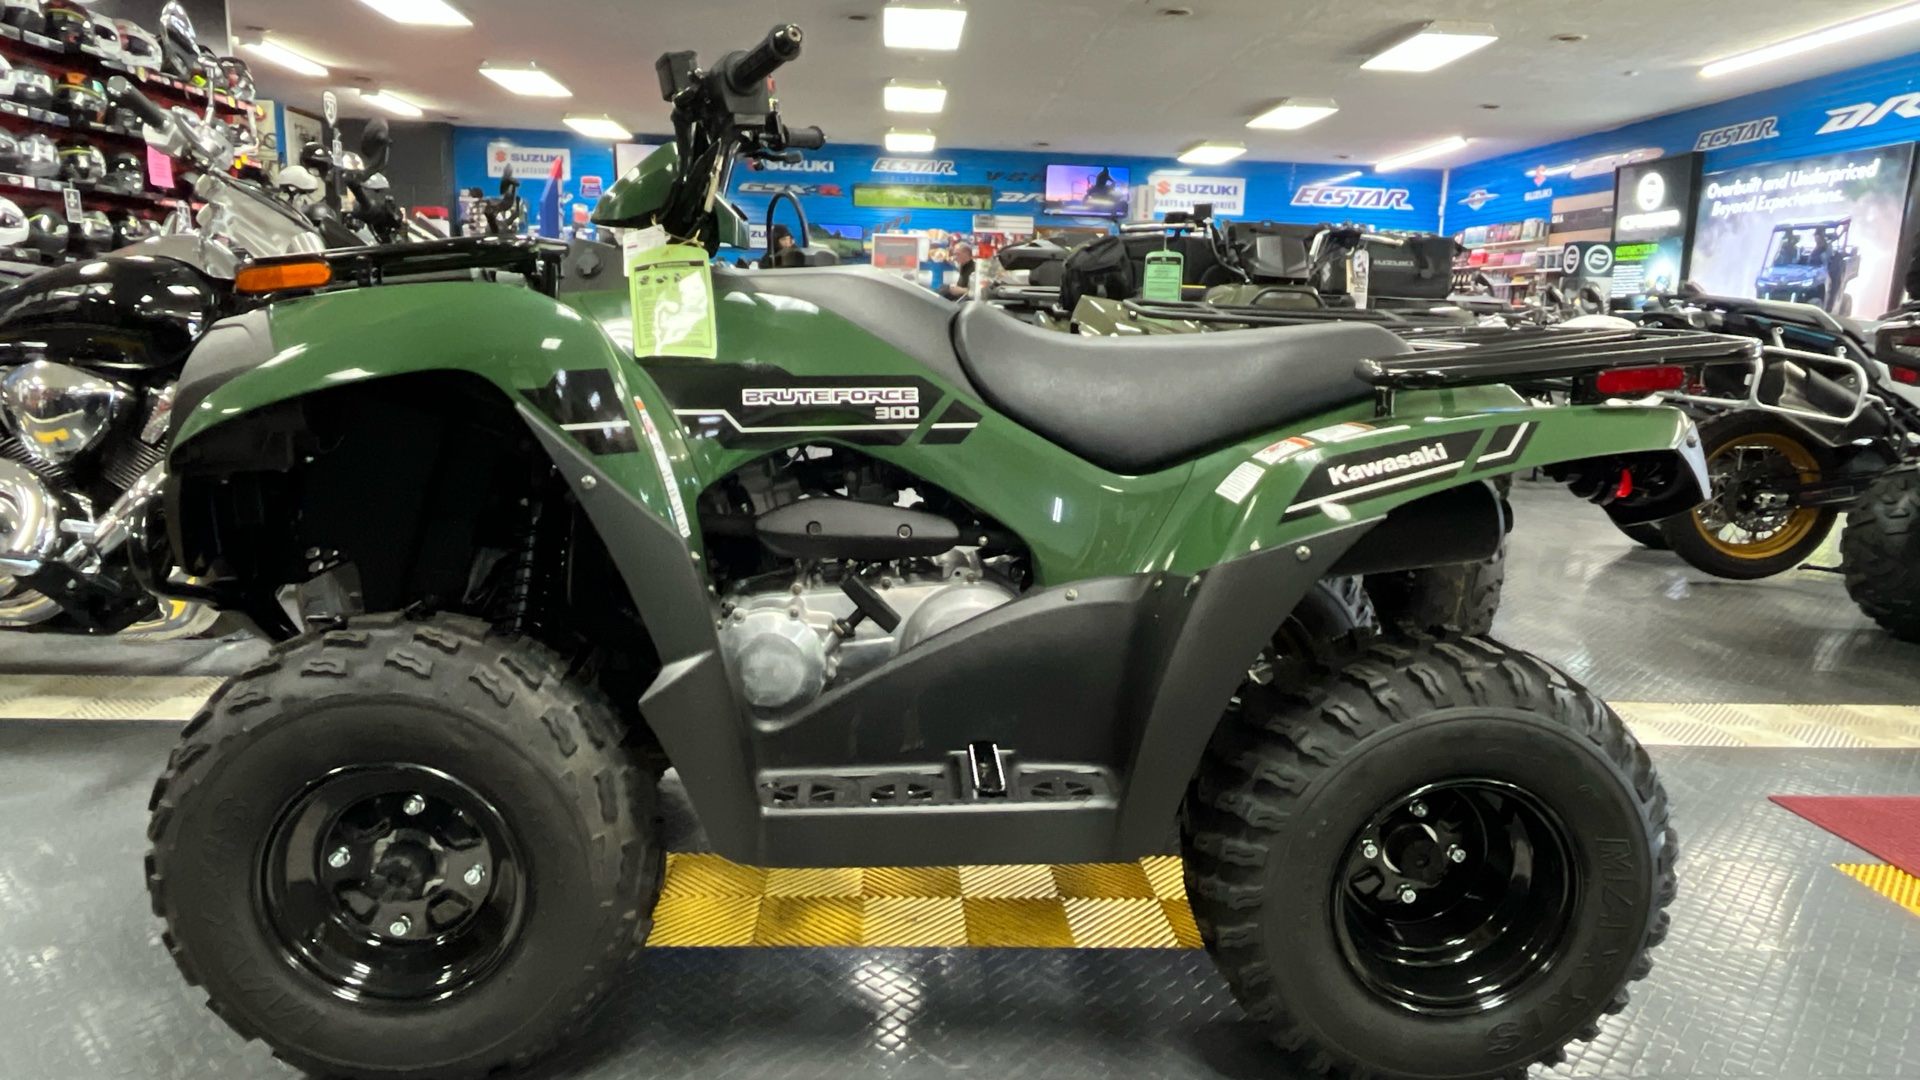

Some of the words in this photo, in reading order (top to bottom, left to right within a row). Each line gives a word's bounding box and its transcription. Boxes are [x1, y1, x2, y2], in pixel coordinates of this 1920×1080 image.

[1692, 116, 1780, 151] ECSTAR
[764, 160, 834, 173] SUZUKI
[872, 157, 958, 175] ECSTAR
[1707, 176, 1762, 199] Overbuilt
[1762, 172, 1790, 192] and
[1790, 158, 1881, 187] Underpriced
[1175, 184, 1238, 195] SUZUKI
[1290, 185, 1414, 210] ECSTAR
[1711, 195, 1757, 219] Beyond
[742, 388, 832, 405] BRUTE
[832, 387, 919, 404] FORCE
[875, 406, 919, 419] 300
[1328, 442, 1448, 486] Kawasaki
